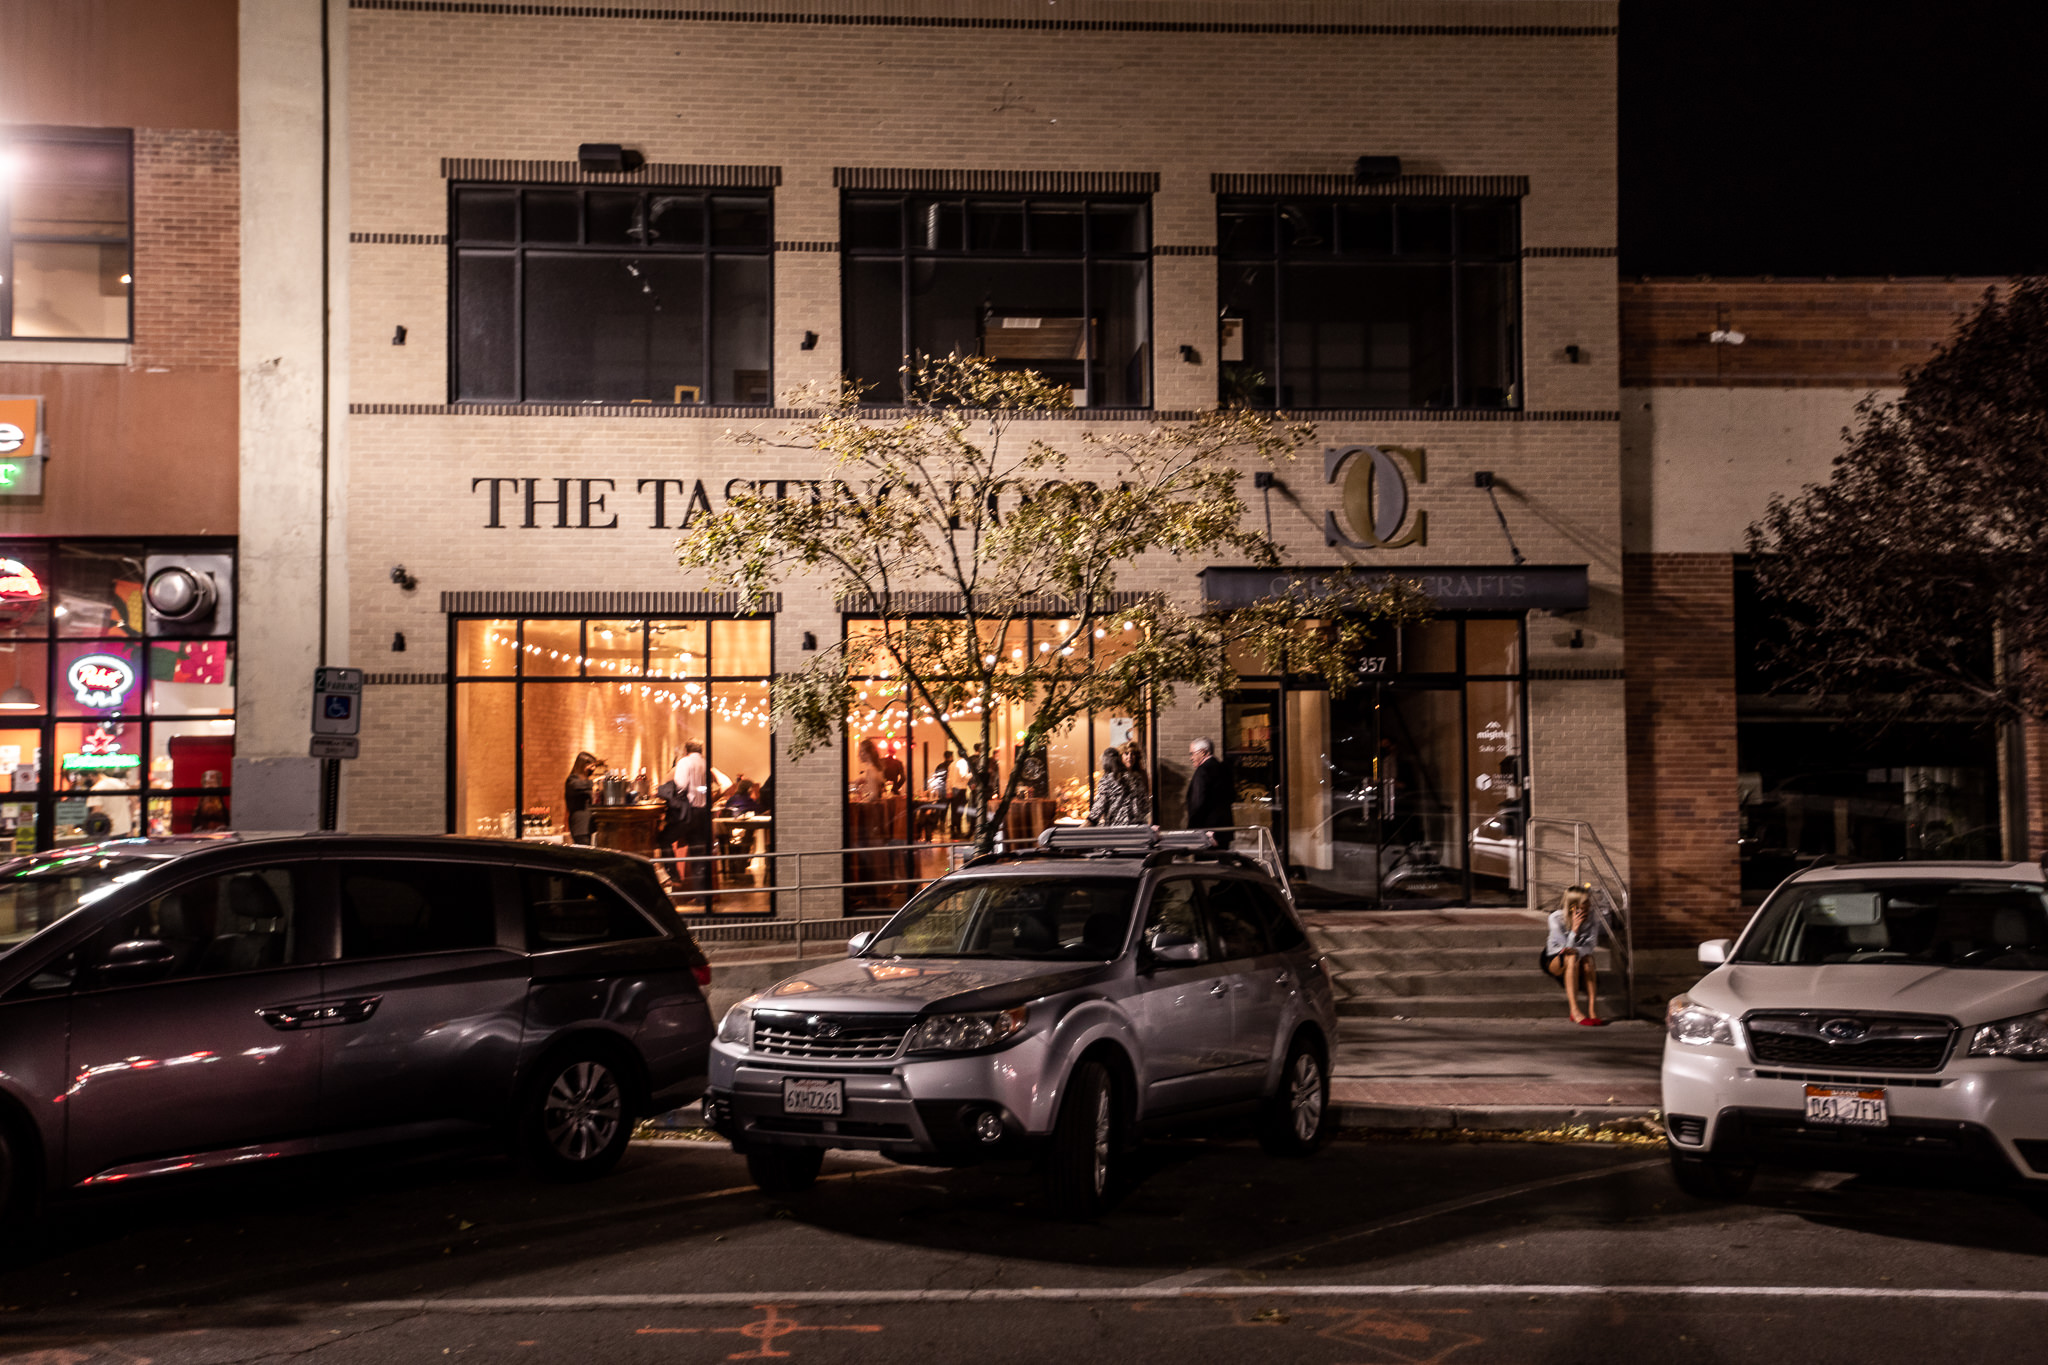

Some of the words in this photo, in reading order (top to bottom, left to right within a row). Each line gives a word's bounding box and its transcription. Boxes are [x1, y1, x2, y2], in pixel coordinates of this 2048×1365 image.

[472, 477, 618, 529] THE
[944, 479, 1139, 530] RO
[1417, 575, 1526, 597] CRAFTS
[1358, 656, 1387, 672] 357
[786, 1090, 841, 1110] 6XHZ261
[1851, 1100, 1883, 1120] 7FH
